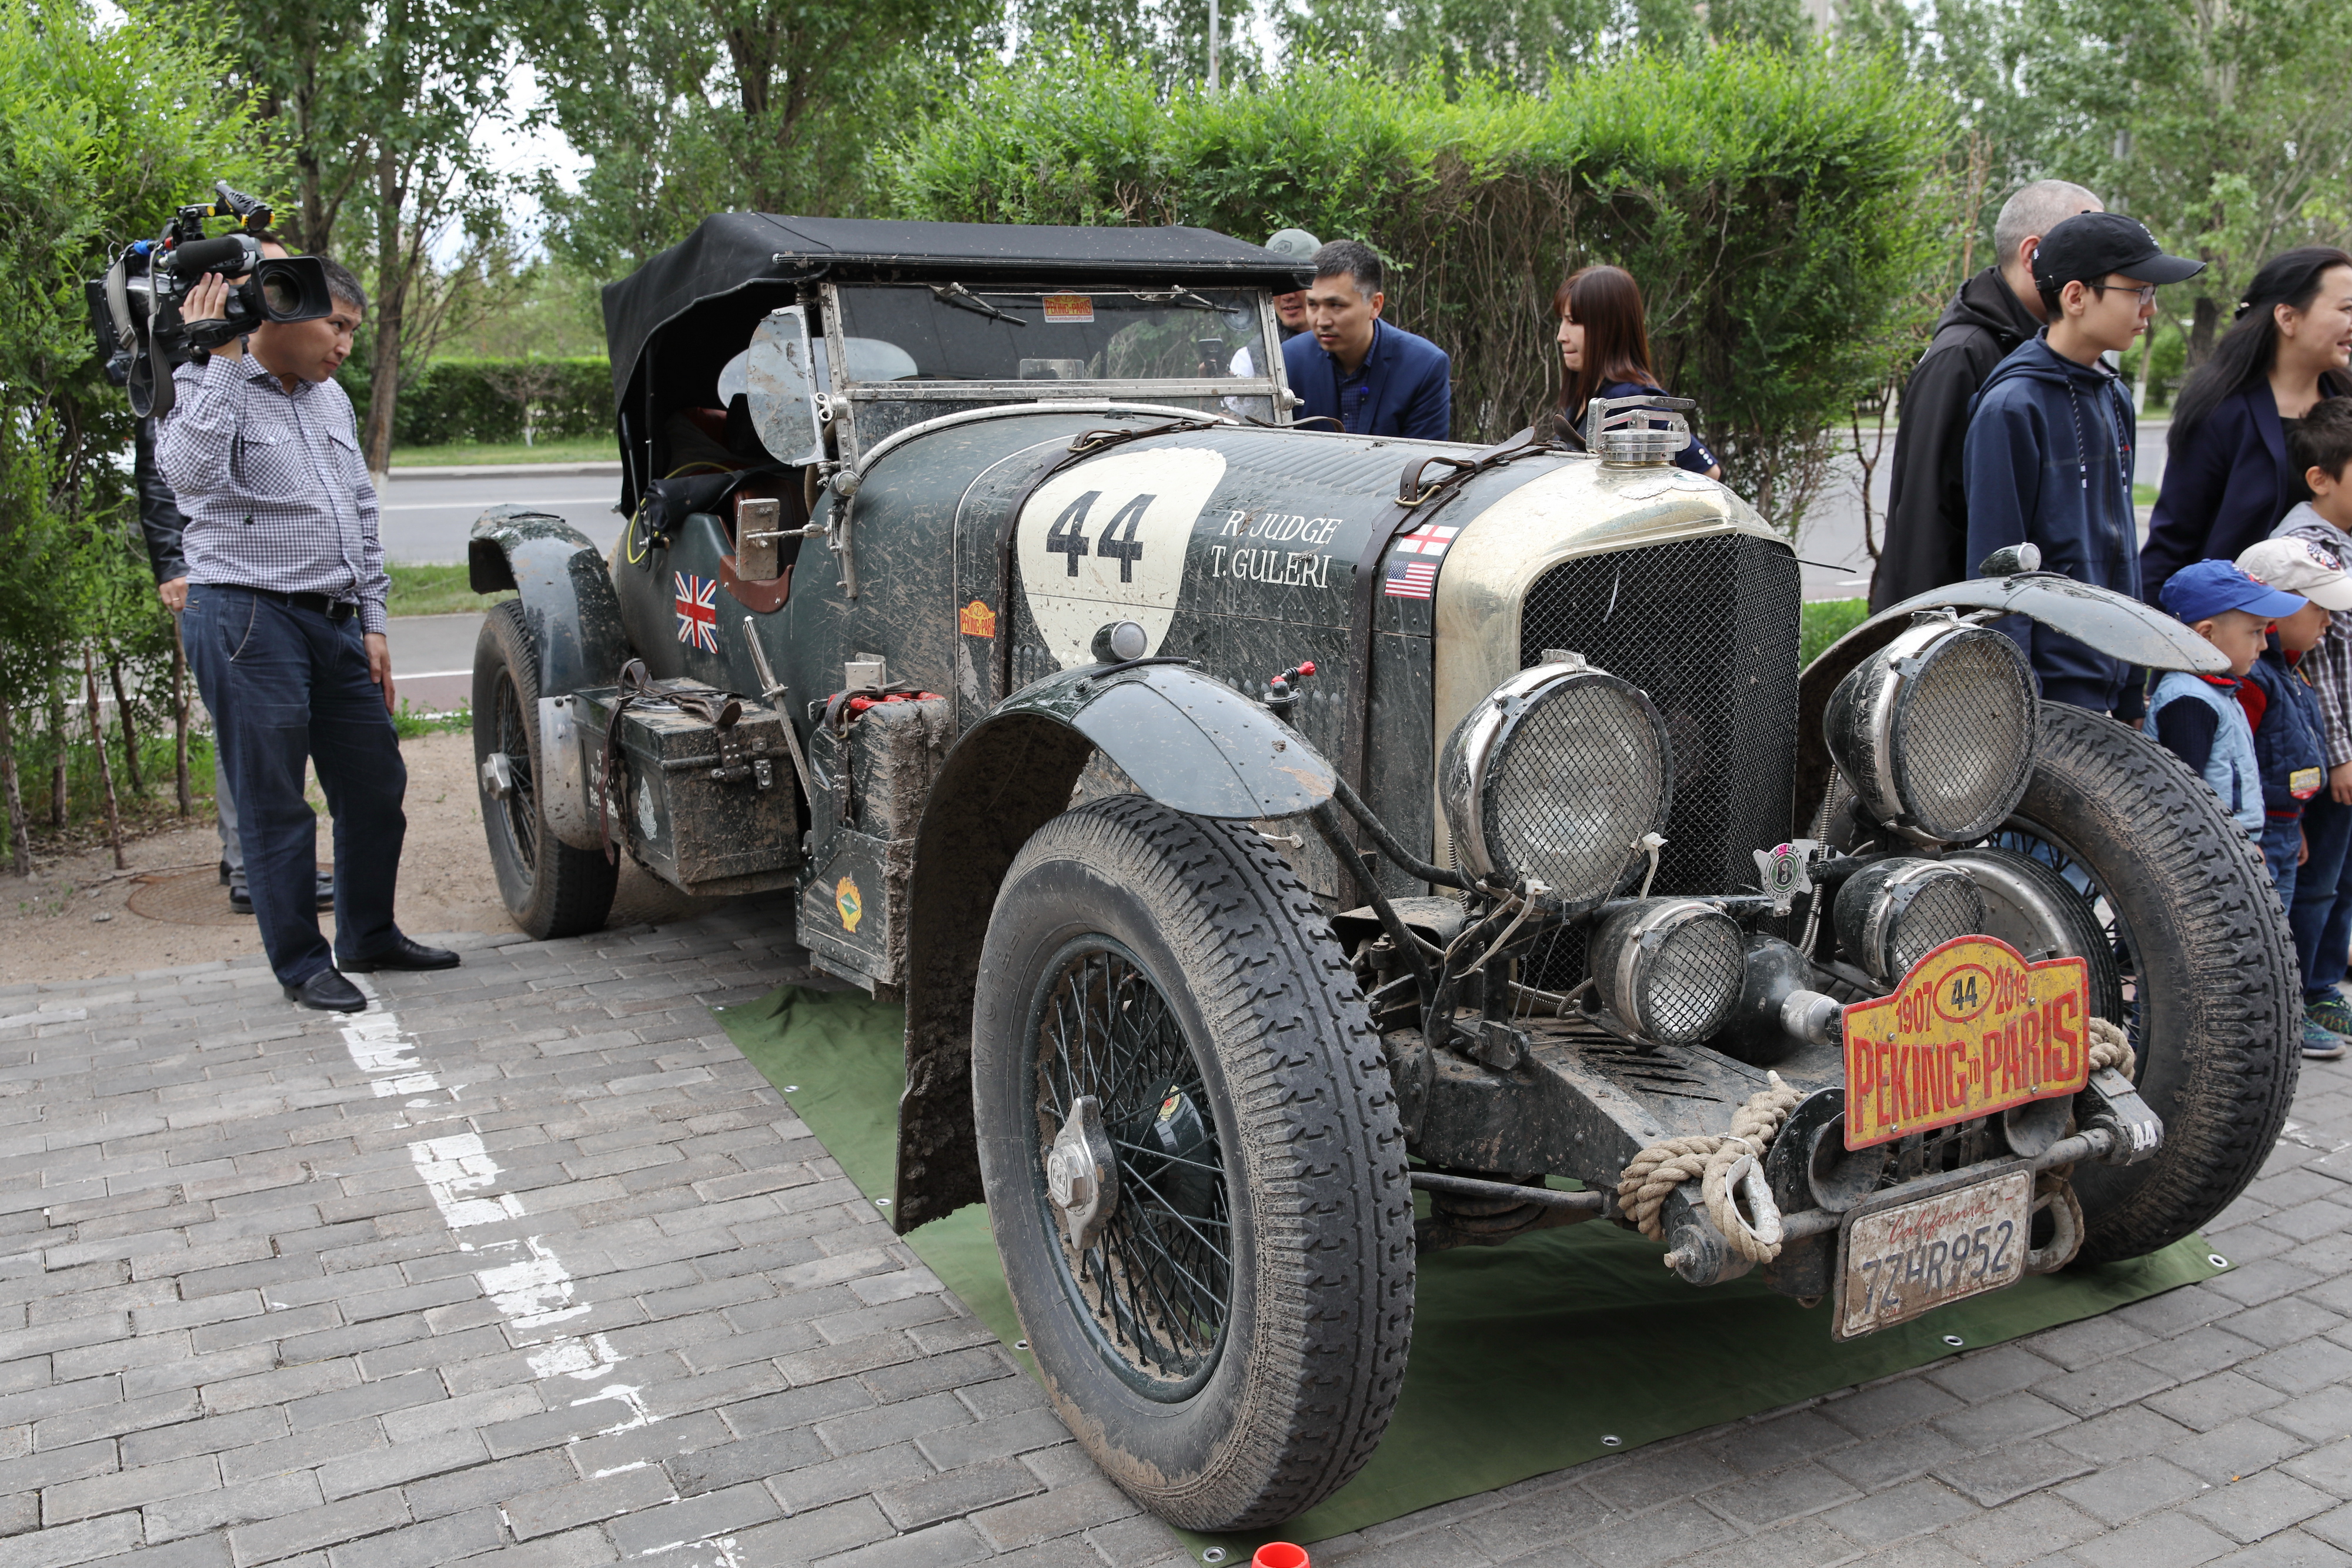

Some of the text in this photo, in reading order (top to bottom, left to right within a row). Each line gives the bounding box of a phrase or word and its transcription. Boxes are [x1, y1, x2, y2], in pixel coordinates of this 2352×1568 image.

[1045, 299, 1069, 315] PEKING
[1071, 299, 1091, 315] PARIS
[1046, 490, 1157, 583] 44
[1248, 513, 1343, 546] JUDGE
[1210, 544, 1332, 589] T. GULERI
[961, 611, 980, 634] PEKING
[1770, 844, 1800, 859] BENTLEY
[1776, 859, 1794, 887] B
[1765, 877, 1803, 900] DRIVERS CLUB
[974, 890, 1038, 1078] MICHELIN
[1896, 964, 2029, 1034] 1907 44 2019
[1853, 988, 2079, 1134] PEKING TO PARIS
[1889, 1201, 1997, 1245] California
[1862, 1219, 2014, 1315] 7ZHR952
